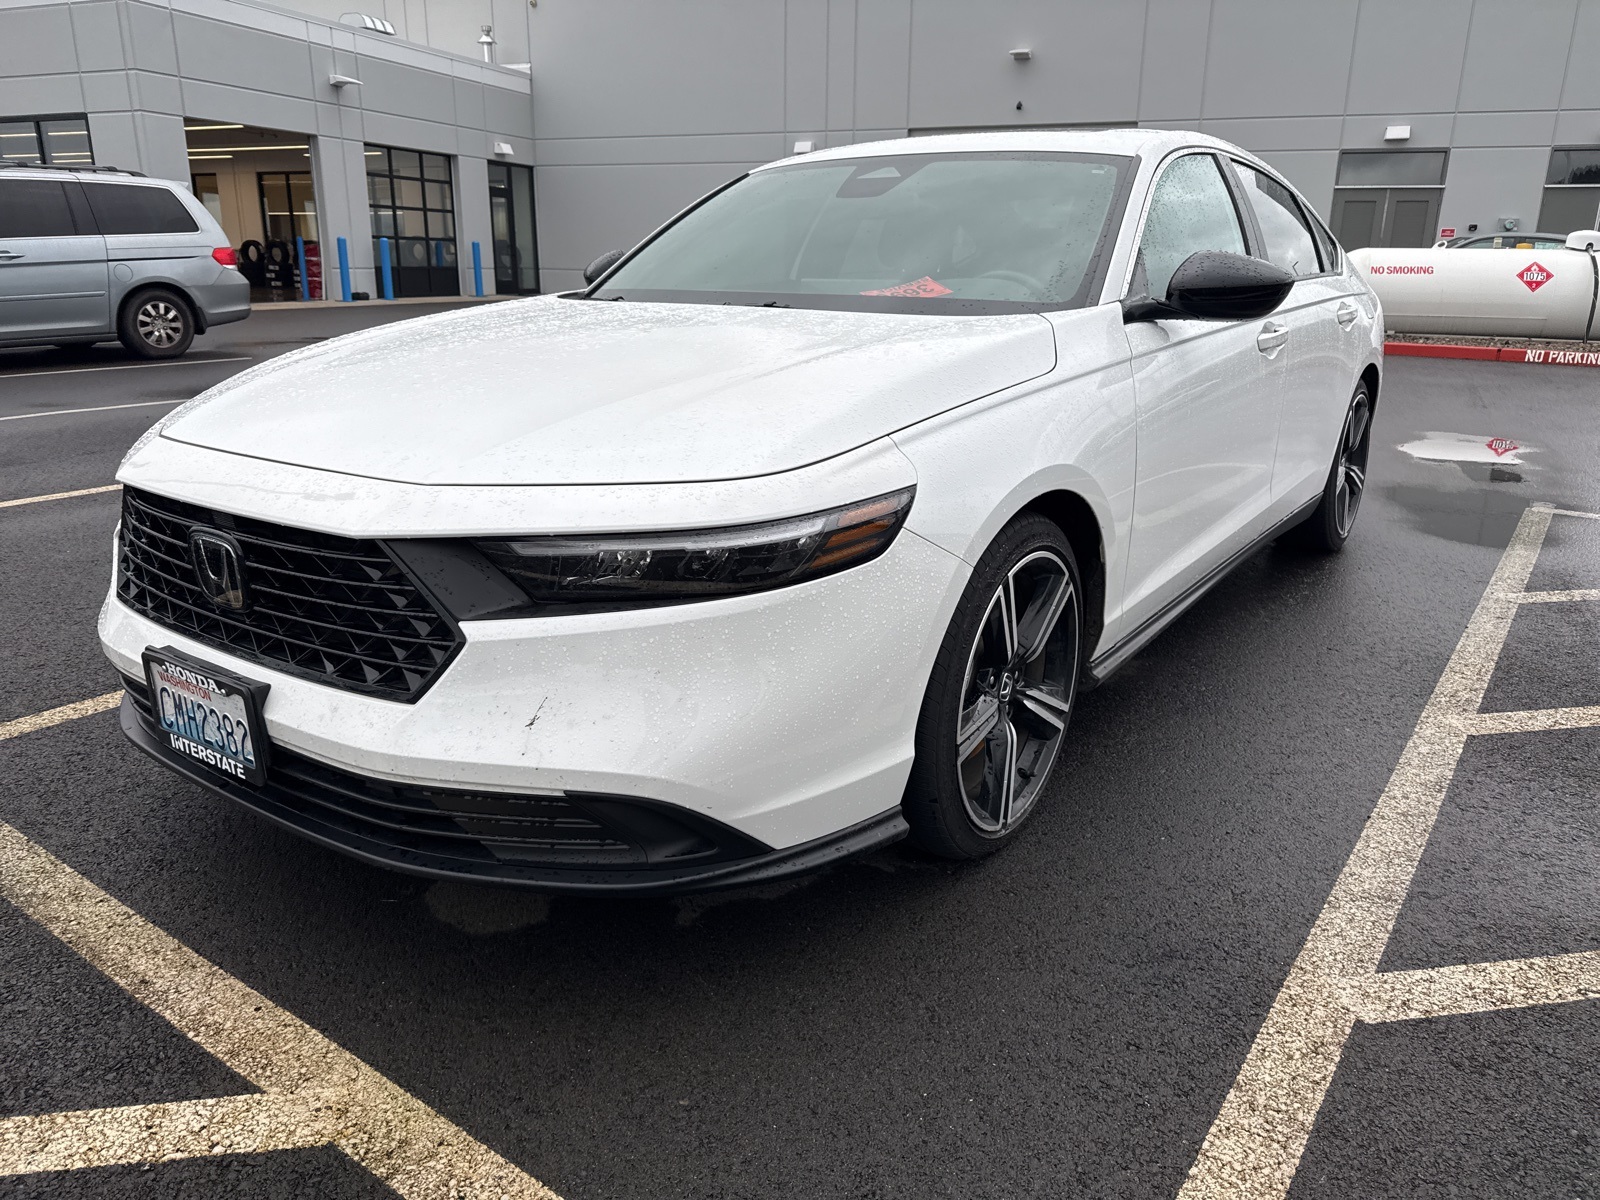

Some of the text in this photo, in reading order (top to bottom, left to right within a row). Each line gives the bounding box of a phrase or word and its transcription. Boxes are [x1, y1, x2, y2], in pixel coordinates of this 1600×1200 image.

[1370, 266, 1434, 275] NO SMOKING
[1525, 272, 1546, 280] 1075
[1524, 350, 1545, 362] NO
[157, 670, 212, 702] WASHINGTON
[164, 661, 221, 694] HONDA
[159, 686, 255, 765] CMH2382
[170, 733, 246, 780] INTERSTATE
